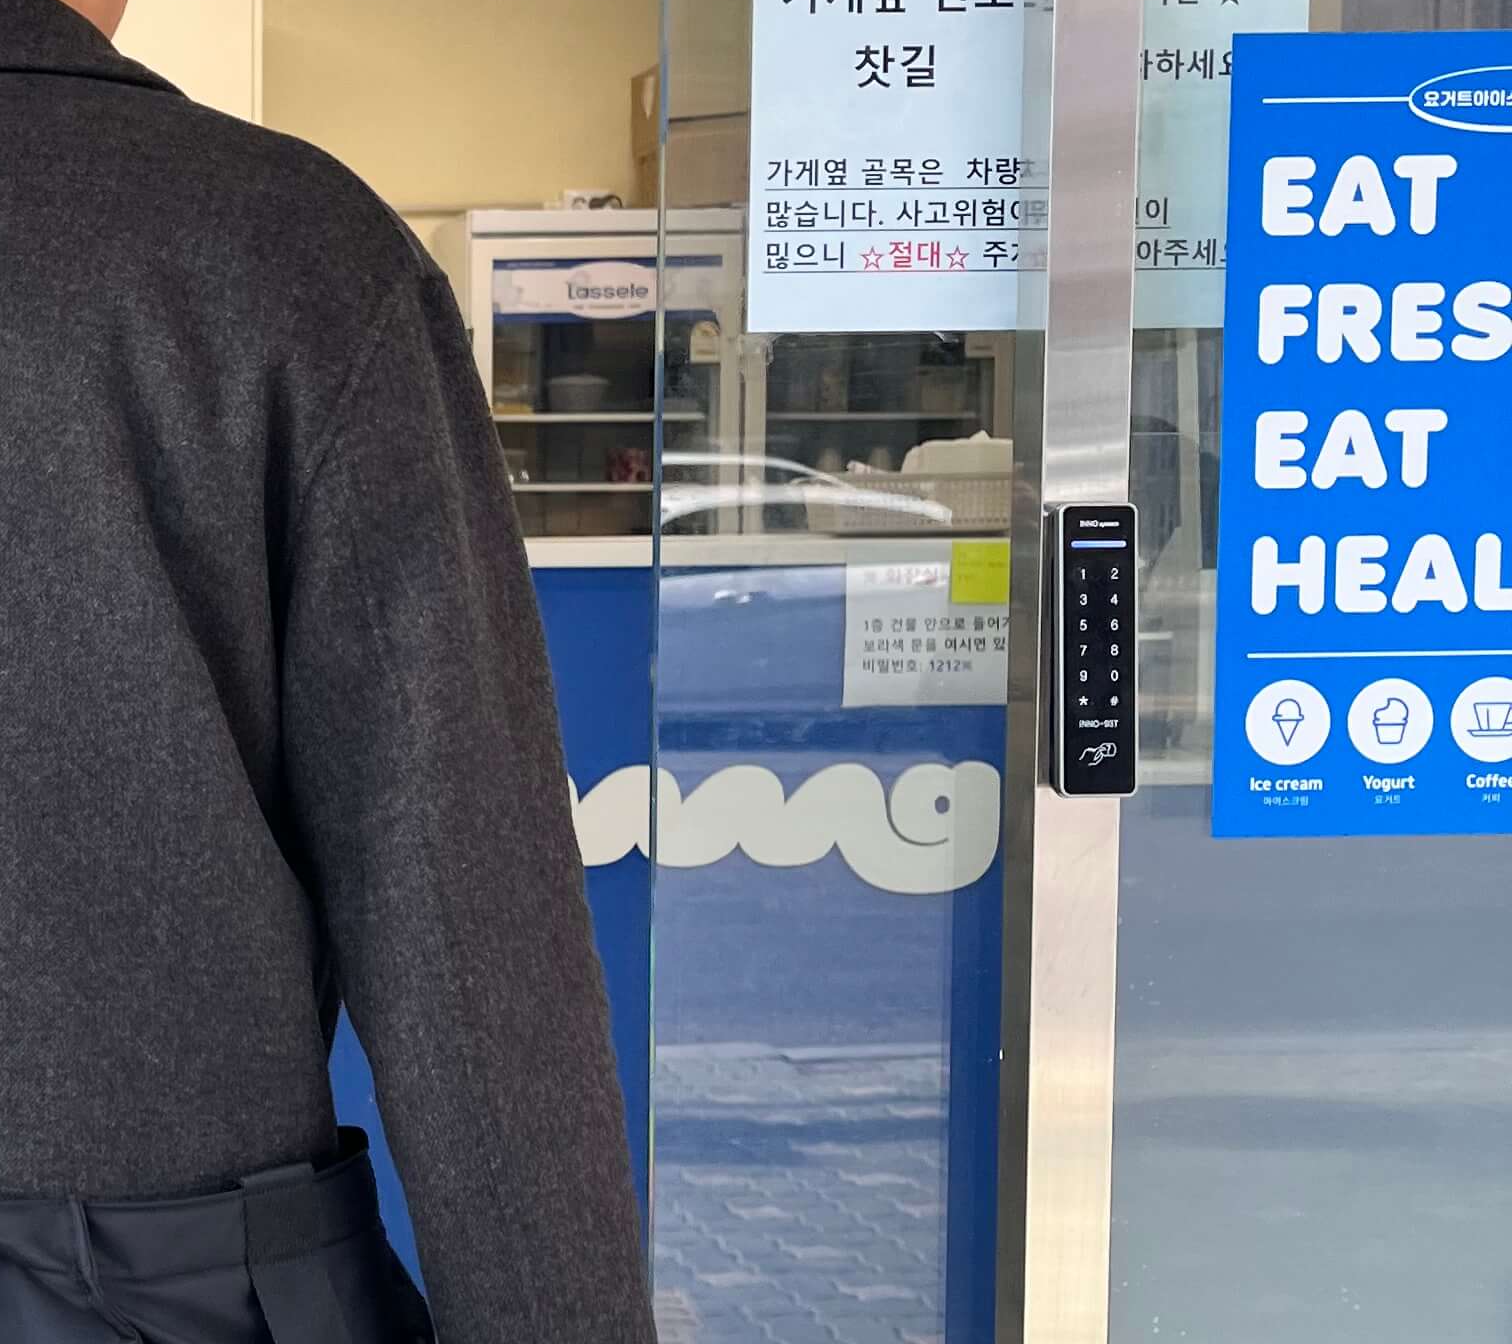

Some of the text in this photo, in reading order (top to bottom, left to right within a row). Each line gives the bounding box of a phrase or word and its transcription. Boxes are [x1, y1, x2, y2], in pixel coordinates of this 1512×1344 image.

[855, 44, 935, 88] 찻길
[767, 158, 848, 187] 가게옆
[862, 158, 944, 186] 골목은
[1262, 154, 1458, 237] EAT
[767, 199, 885, 228] 많습니다.
[888, 241, 940, 269] 절대
[1258, 281, 1512, 365] FRES
[1255, 409, 1448, 489] EAT
[1080, 568, 1119, 581] 1 2
[1251, 533, 1512, 615] HEAL
[1079, 594, 1119, 606] 3 4
[1079, 619, 1119, 632] 5 6
[1079, 645, 1119, 657] 7 8
[1079, 670, 1088, 682] 9
[1250, 777, 1323, 792] Ice cream
[1363, 775, 1416, 793] Yogurt
